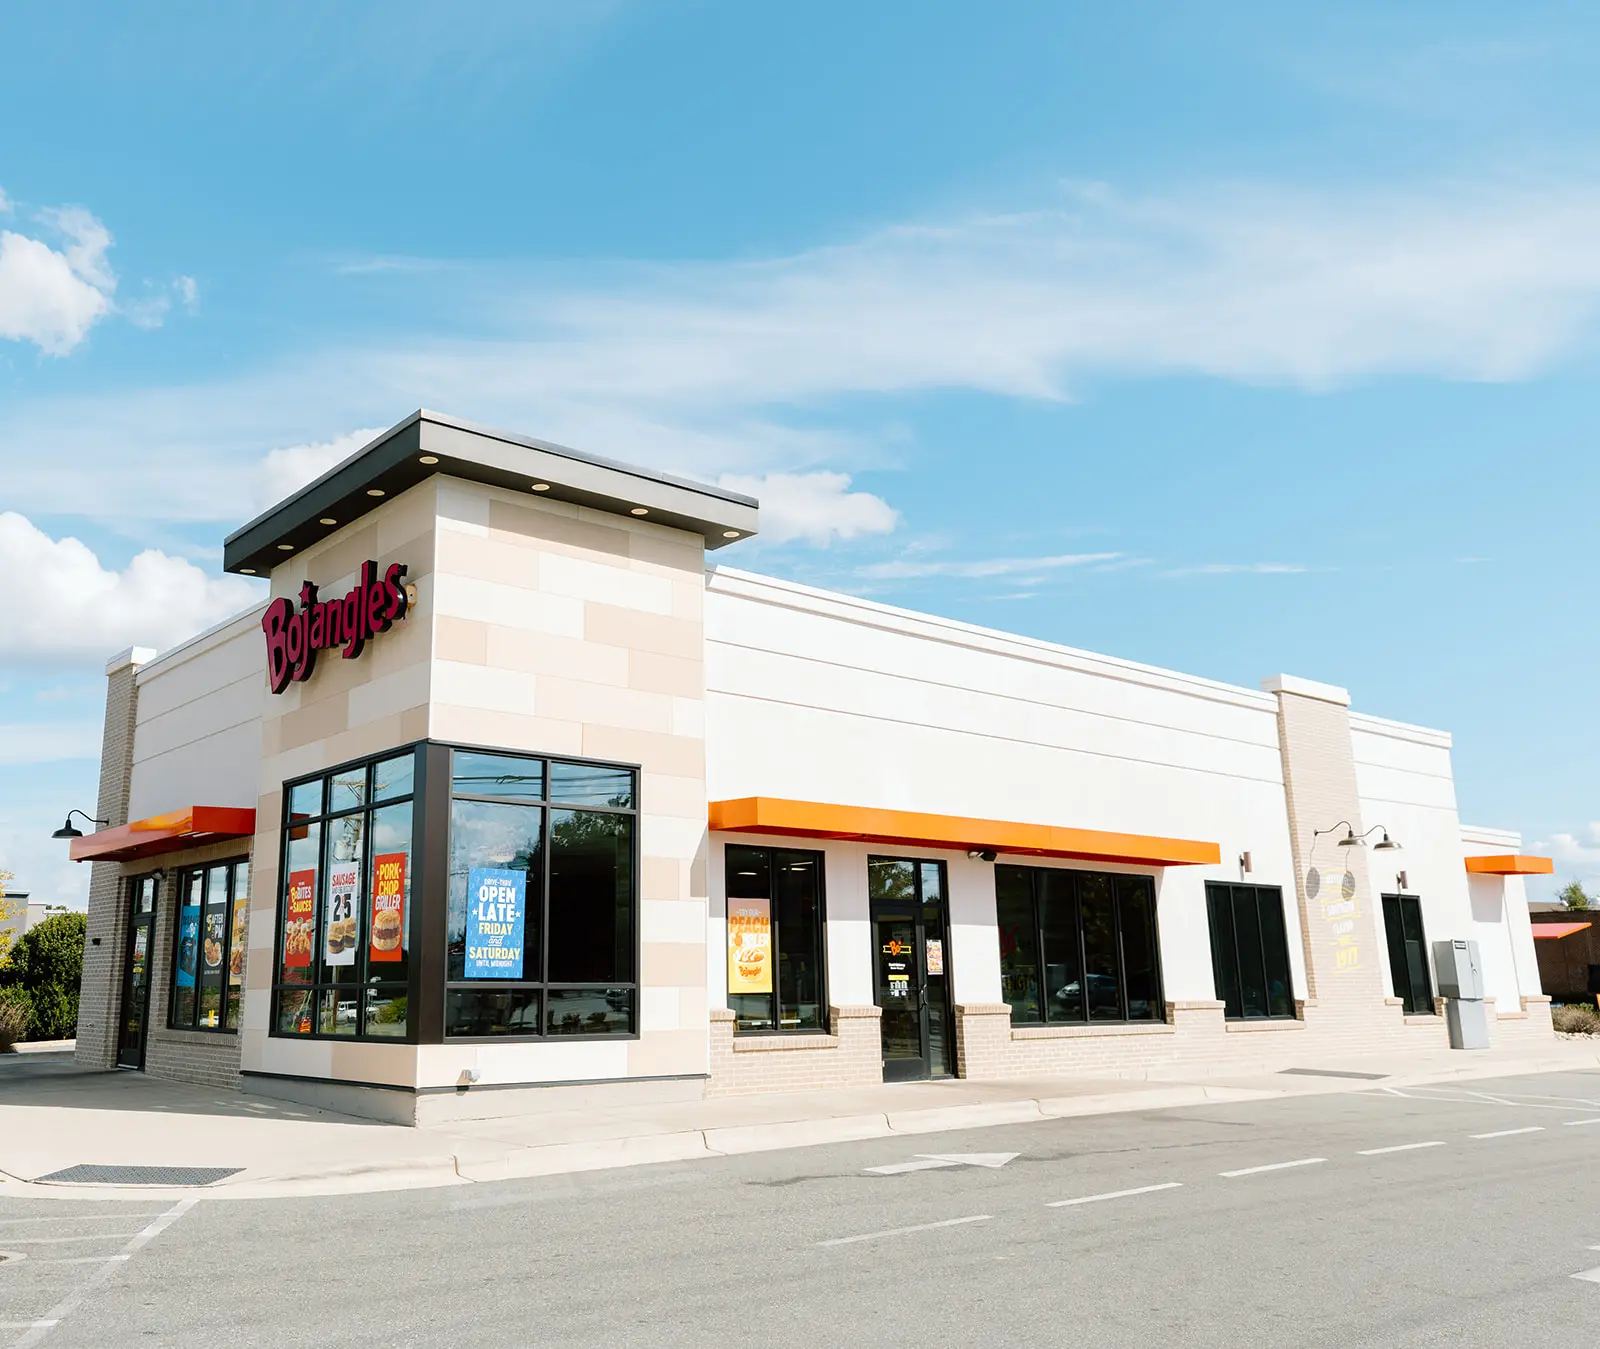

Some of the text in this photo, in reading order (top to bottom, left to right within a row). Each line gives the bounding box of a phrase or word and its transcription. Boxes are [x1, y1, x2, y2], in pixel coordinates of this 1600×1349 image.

[262, 560, 407, 694] Bojangles
[332, 872, 356, 887] SAUSAGE
[379, 863, 400, 880] PORK
[378, 880, 399, 896] CHOP
[478, 885, 516, 904] OPEN
[375, 894, 401, 911] GRILLER
[478, 902, 516, 922] LATE
[478, 922, 514, 936] FRIDAY
[730, 916, 769, 934] PEACH
[469, 946, 521, 961] SATURDAY
